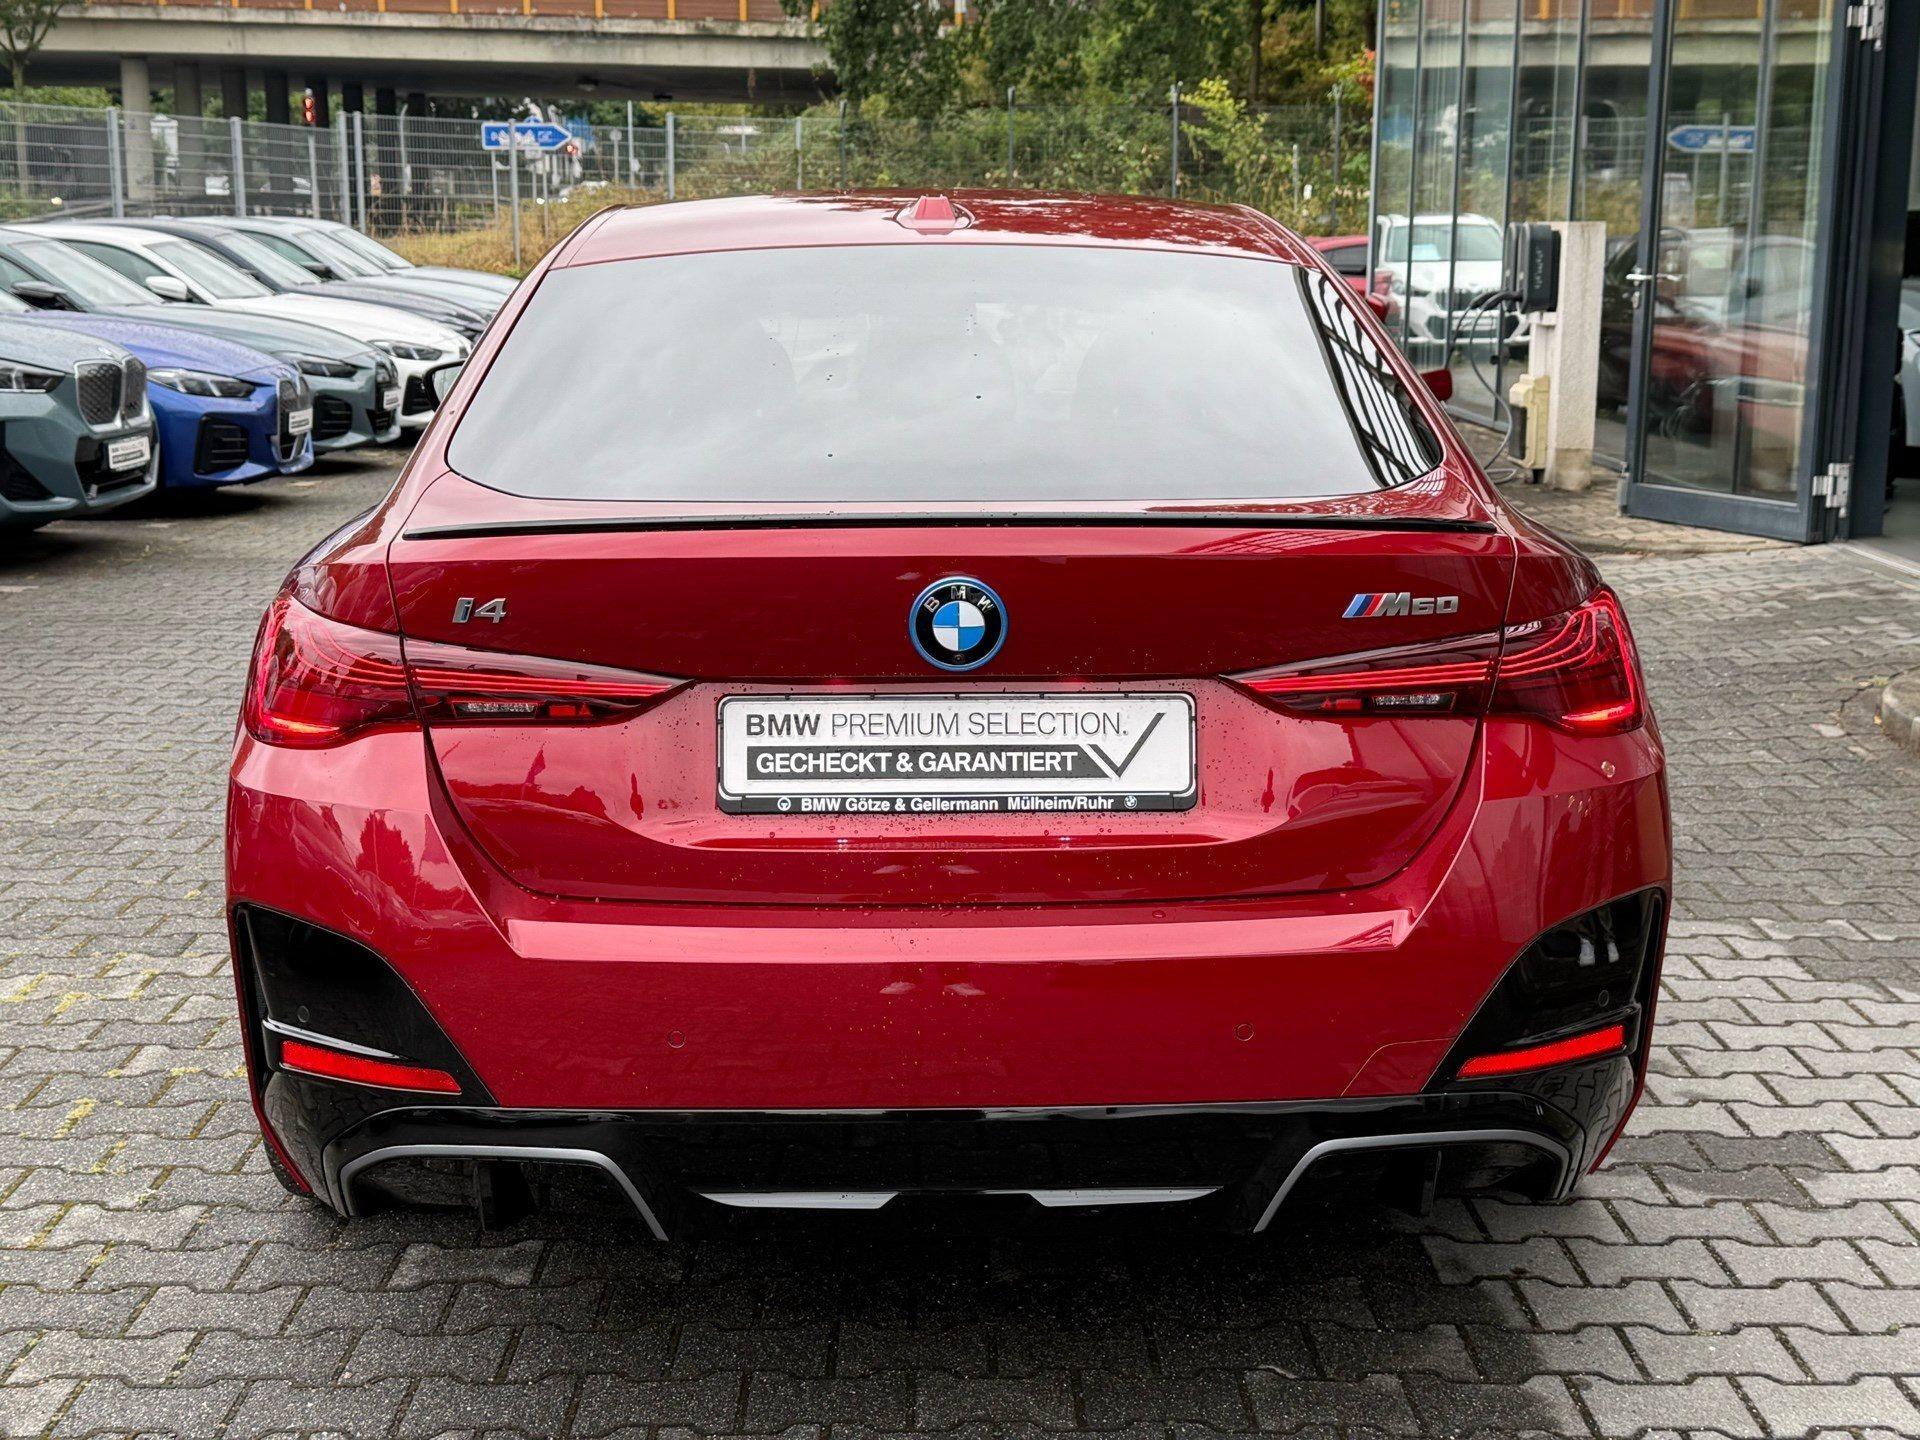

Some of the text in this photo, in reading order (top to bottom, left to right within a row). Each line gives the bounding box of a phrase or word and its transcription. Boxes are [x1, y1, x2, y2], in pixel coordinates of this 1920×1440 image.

[452, 597, 507, 624] i4
[923, 585, 995, 614] BMW
[1370, 592, 1459, 617] M60
[746, 711, 1128, 736] BMW PREMIUM SELECTION.
[756, 751, 1078, 773] GECHECKT & GARANTIERT
[801, 796, 1114, 812] BMW Götze & Gellermann Mülheim/Ruhr
